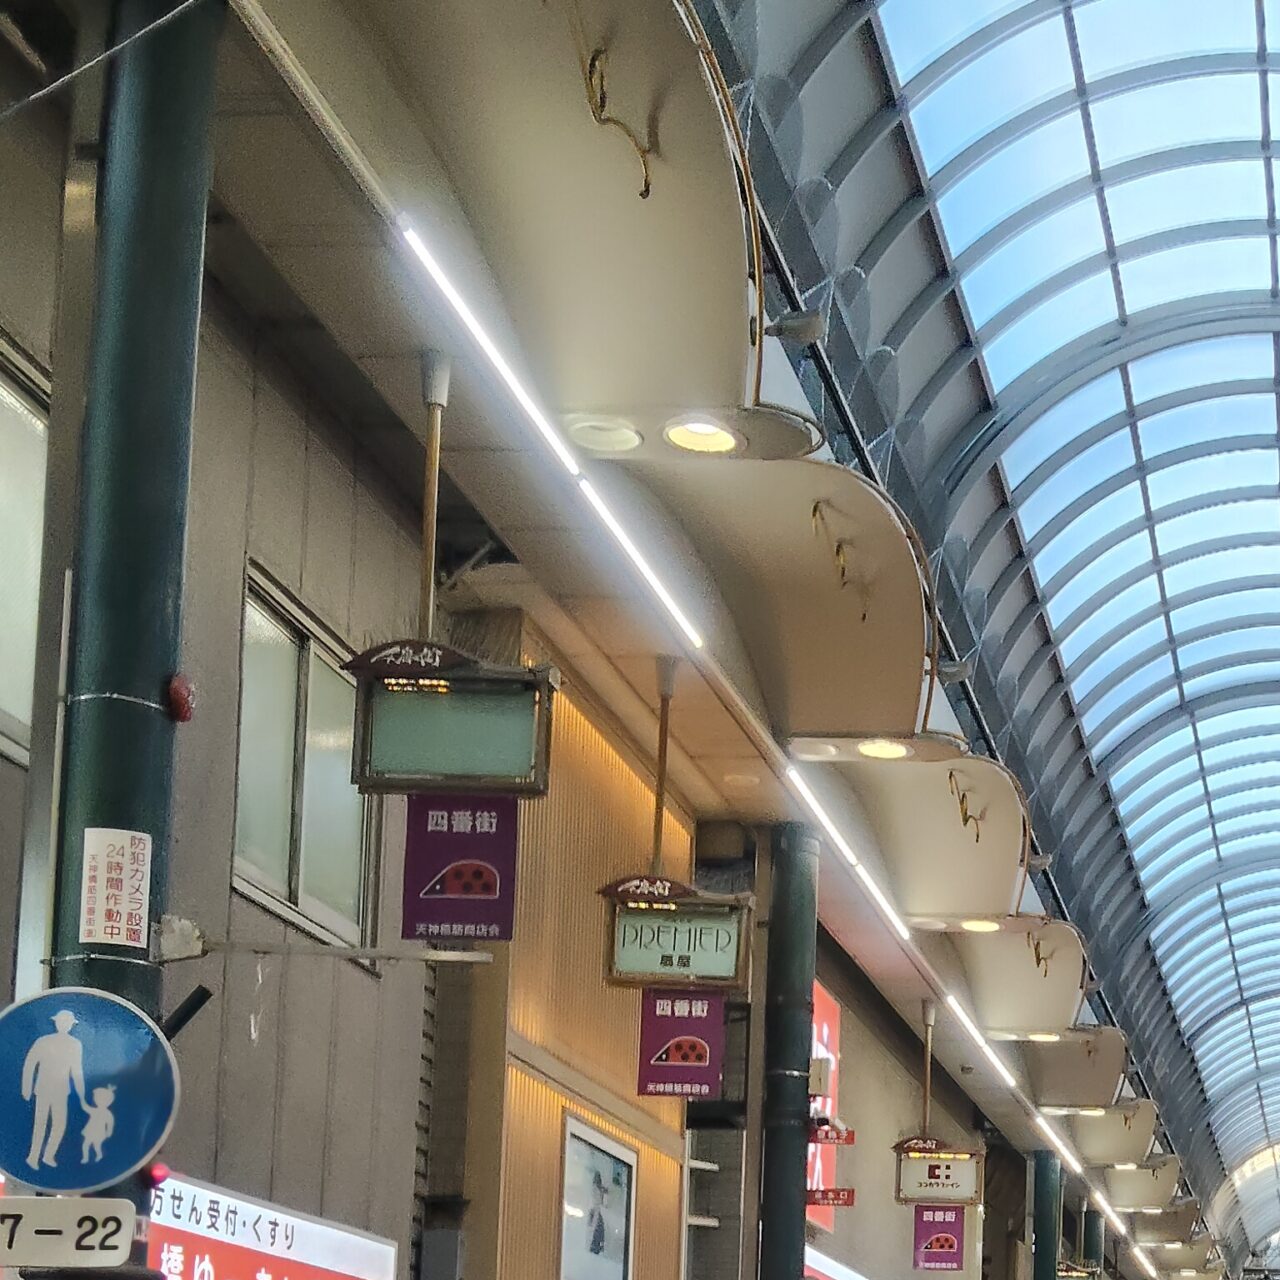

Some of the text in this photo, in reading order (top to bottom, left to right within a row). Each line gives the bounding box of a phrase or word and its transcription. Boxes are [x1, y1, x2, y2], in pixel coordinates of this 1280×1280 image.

[427, 811, 498, 833] 四番街
[103, 843, 125, 939] 24時間作動中
[126, 835, 147, 943] 防犯カメラ設置
[622, 924, 732, 953] PREMIER
[655, 999, 710, 1018] 四番街
